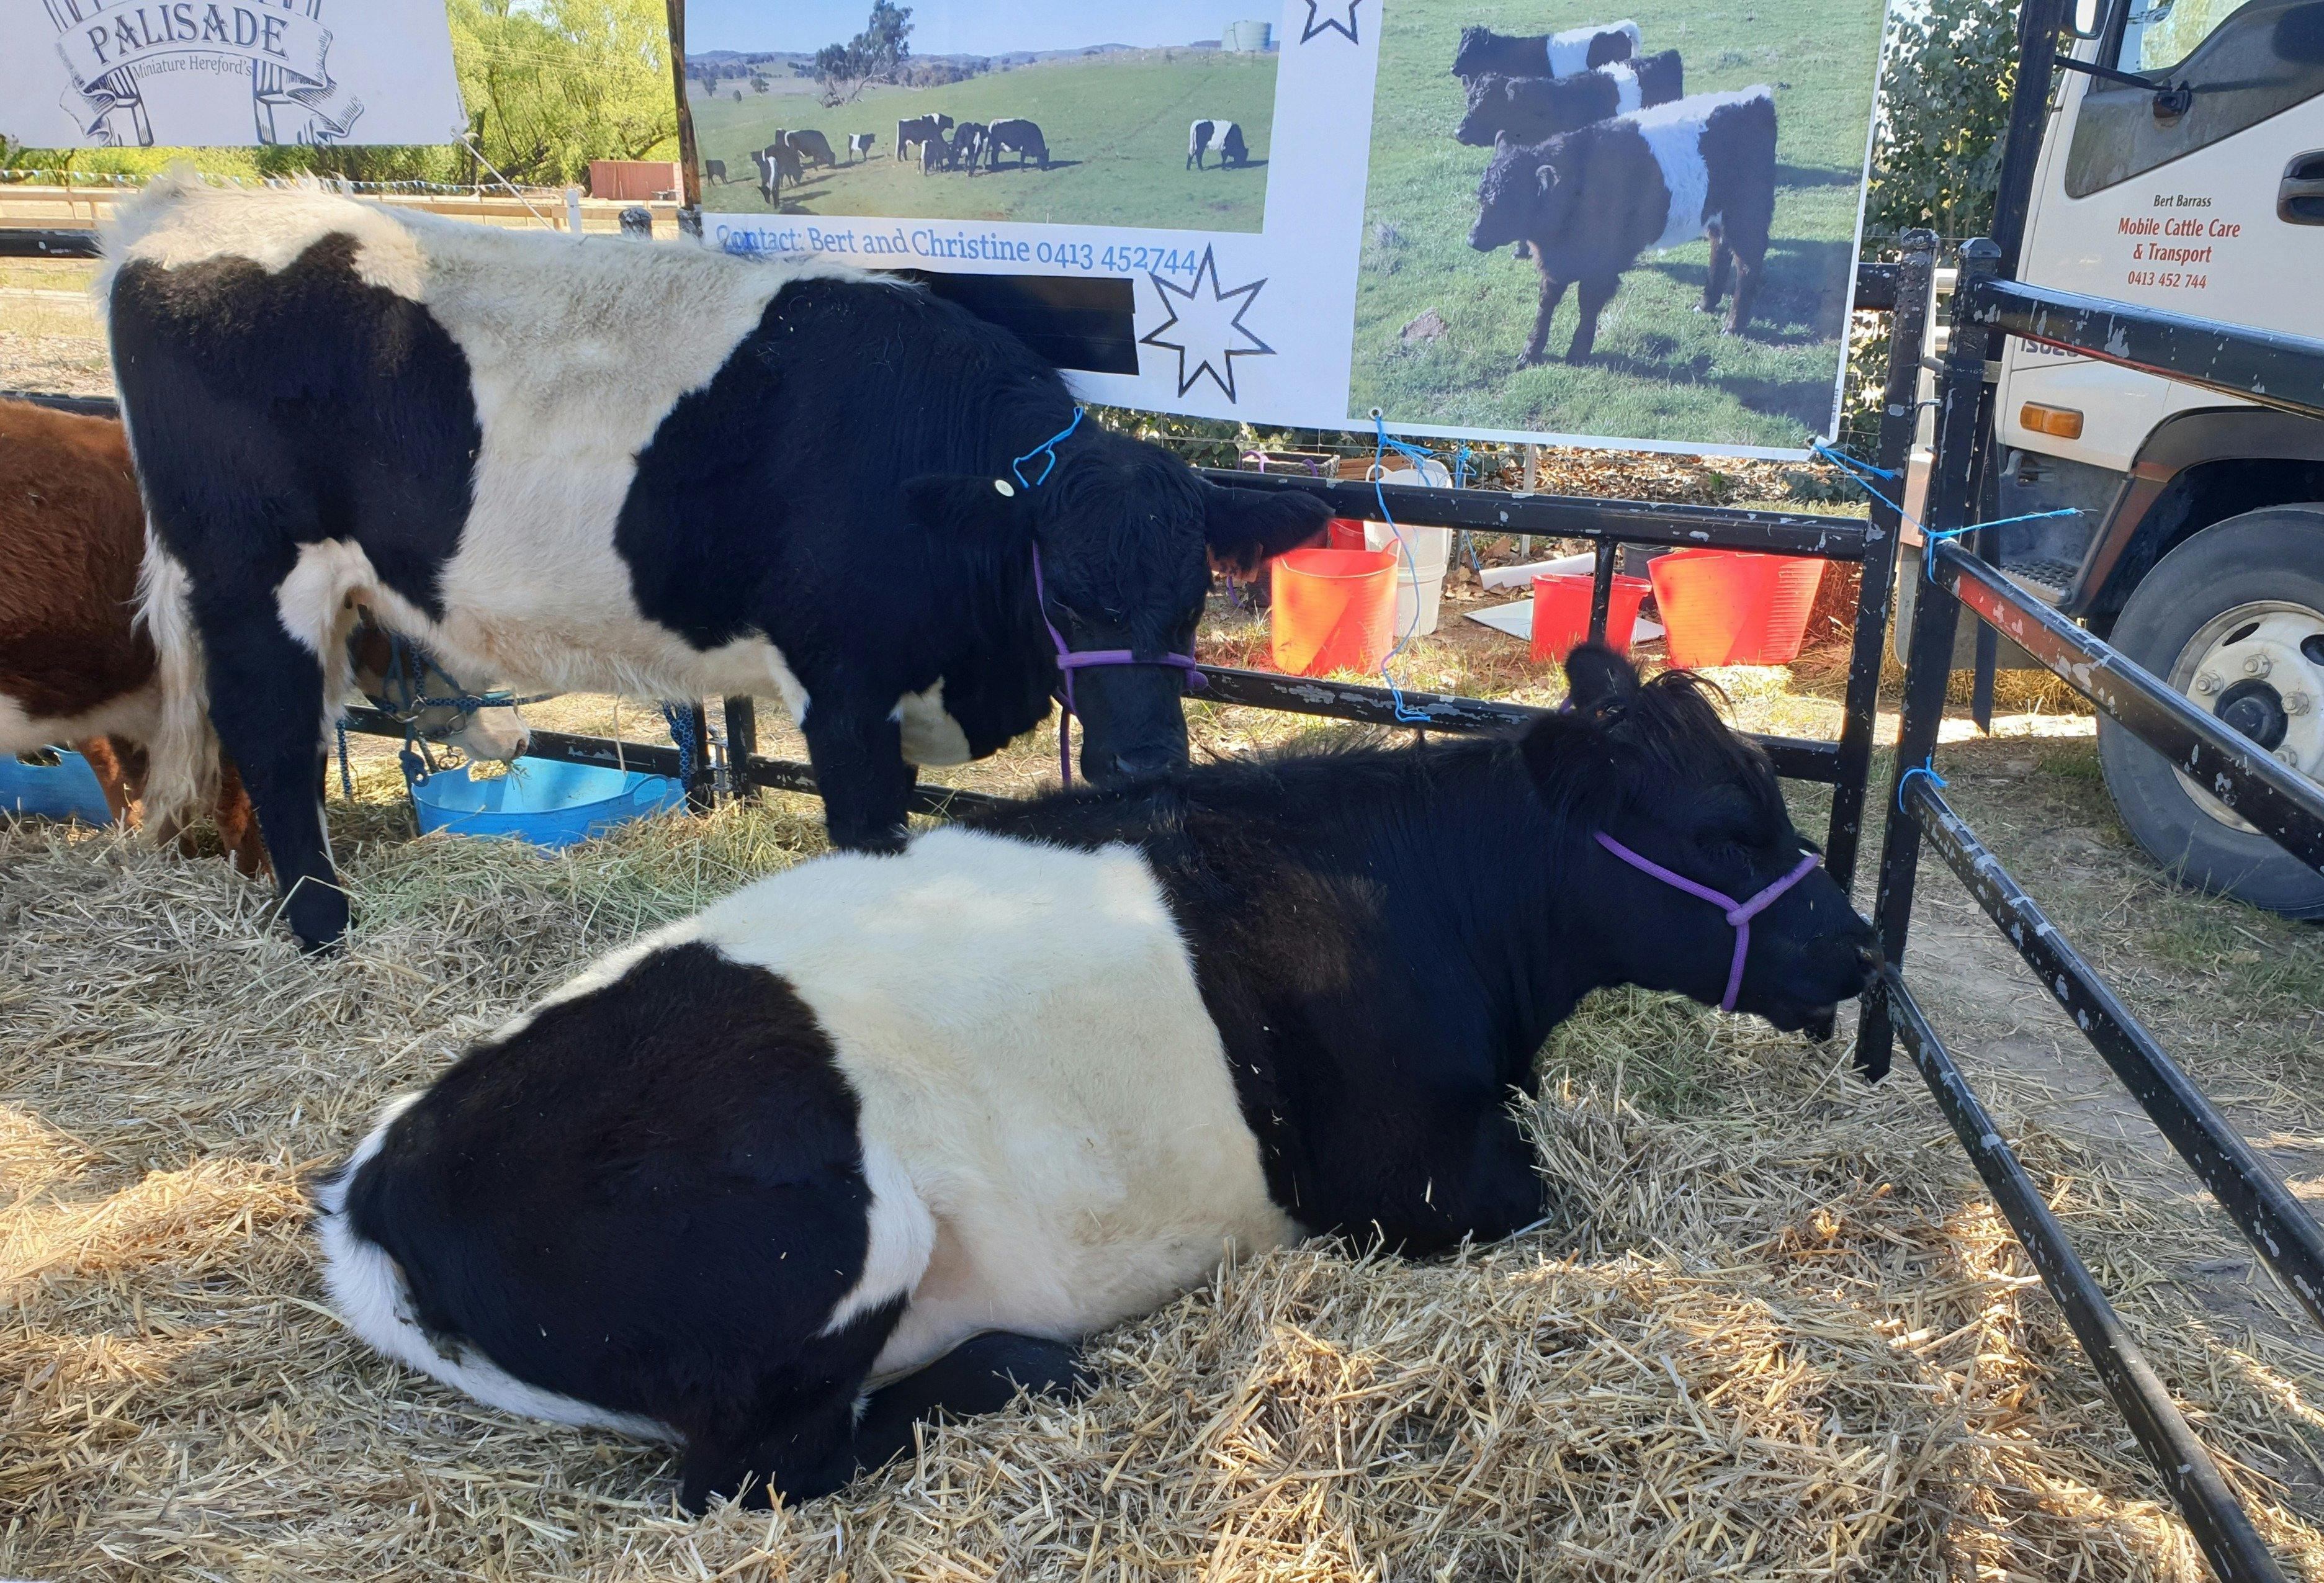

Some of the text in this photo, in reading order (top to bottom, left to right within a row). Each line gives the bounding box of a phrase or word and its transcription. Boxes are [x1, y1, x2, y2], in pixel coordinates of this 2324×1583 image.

[86, 2, 289, 66] PALISADE
[133, 56, 253, 81] Miniature Hereford's
[2153, 194, 2212, 207] Bert Barrass
[2117, 217, 2241, 238] Mobile Cattle Care
[716, 224, 1198, 276] Contact: Bert and Christine 0413 452744
[2133, 243, 2212, 266] & Transport
[2127, 271, 2207, 289] 0413 452 744
